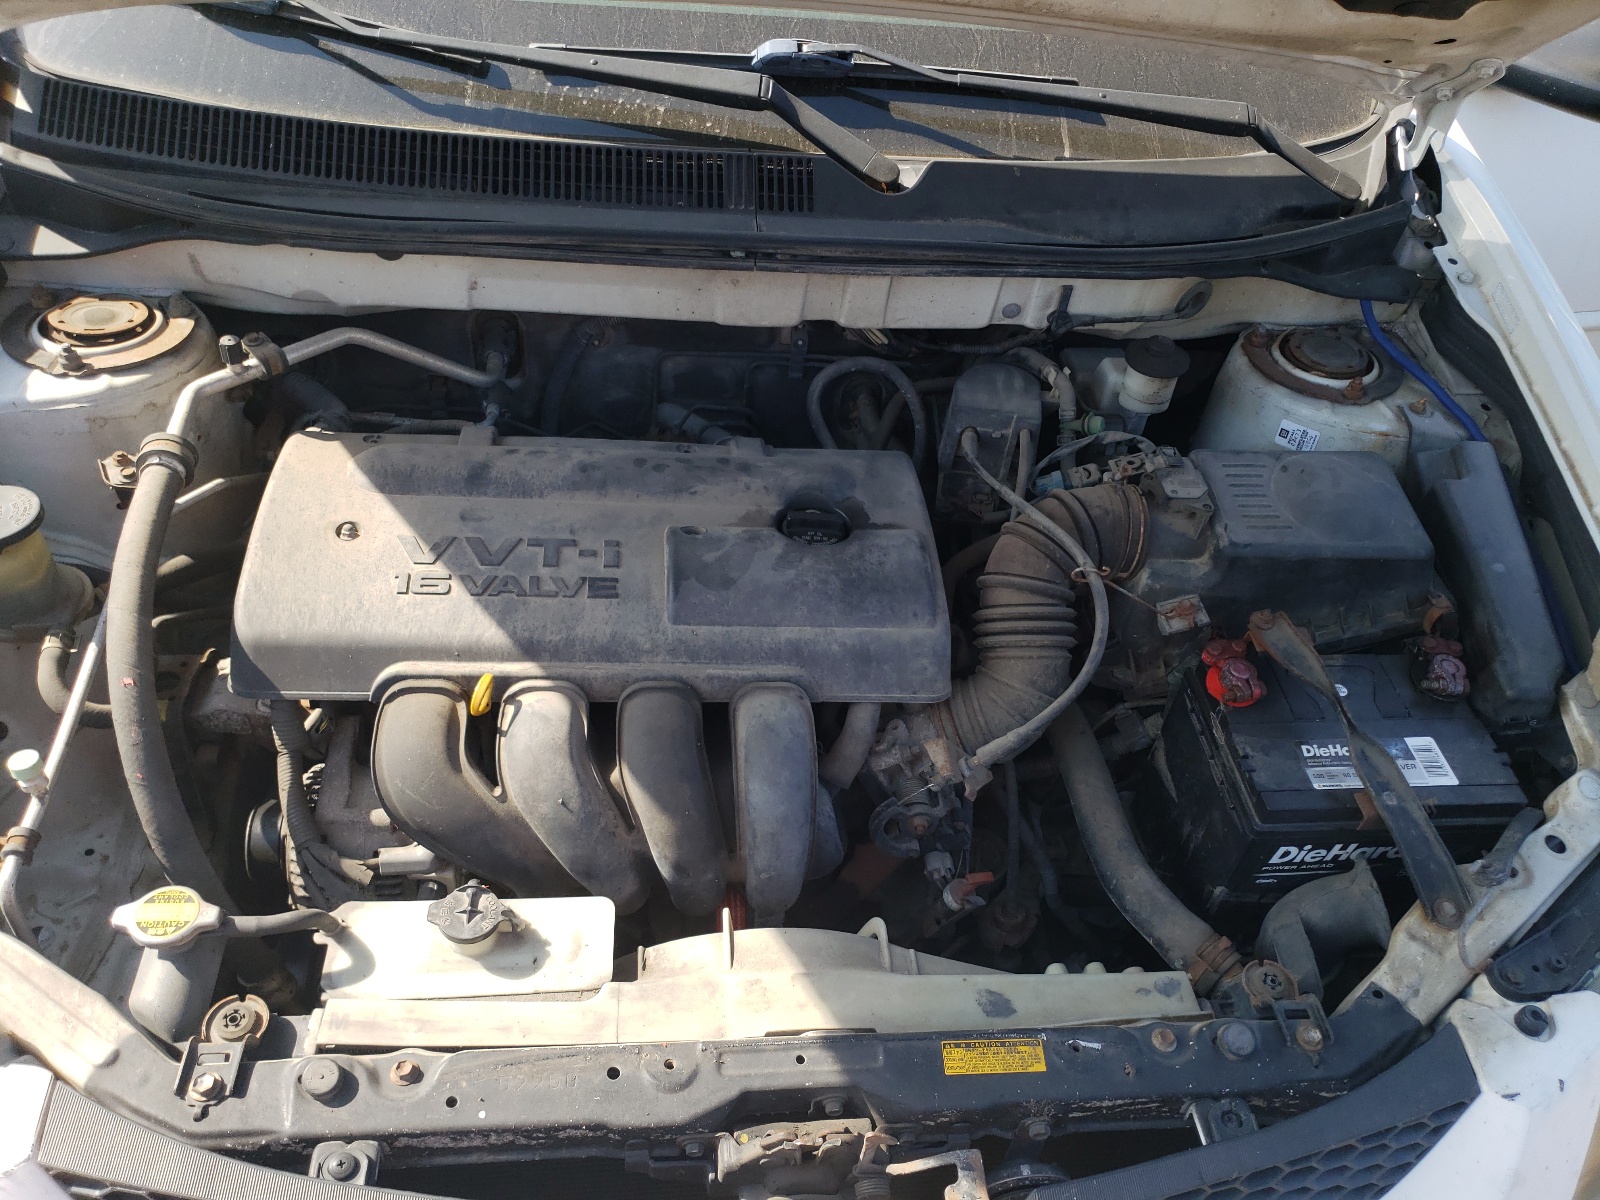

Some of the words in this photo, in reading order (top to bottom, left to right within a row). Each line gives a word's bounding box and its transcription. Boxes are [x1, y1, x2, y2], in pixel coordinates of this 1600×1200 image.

[395, 573, 452, 596] 16
[458, 574, 619, 598] VALVE
[140, 921, 184, 929] CAUTION
[485, 896, 498, 930] COOLANT
